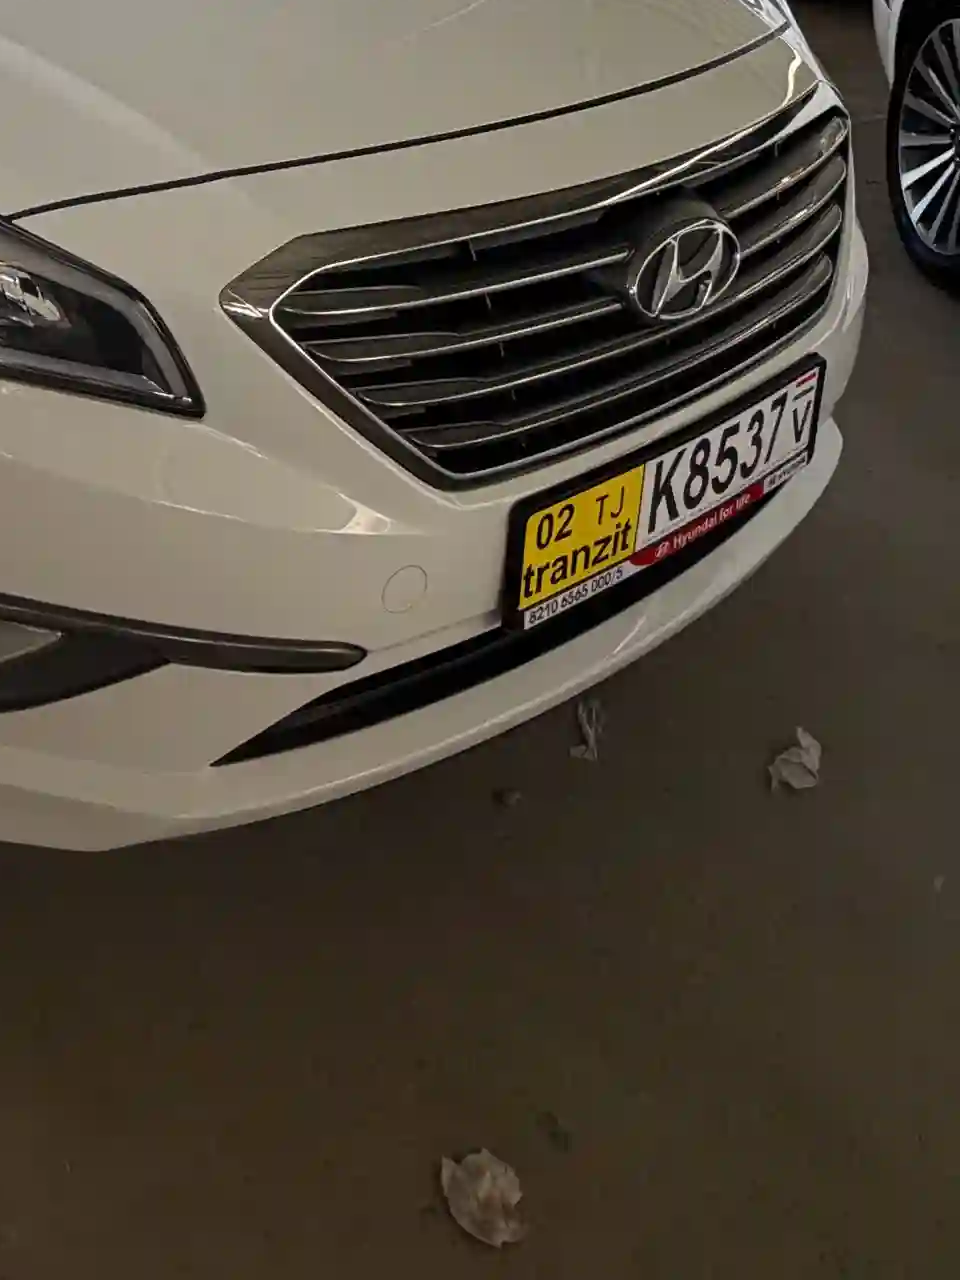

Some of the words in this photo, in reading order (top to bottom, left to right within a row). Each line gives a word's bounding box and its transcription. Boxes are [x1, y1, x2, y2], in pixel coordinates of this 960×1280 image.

[648, 391, 788, 535] K8537
[536, 503, 575, 550] 02
[596, 485, 626, 526] TJ
[719, 505, 735, 523] for
[522, 522, 632, 599] tranzit
